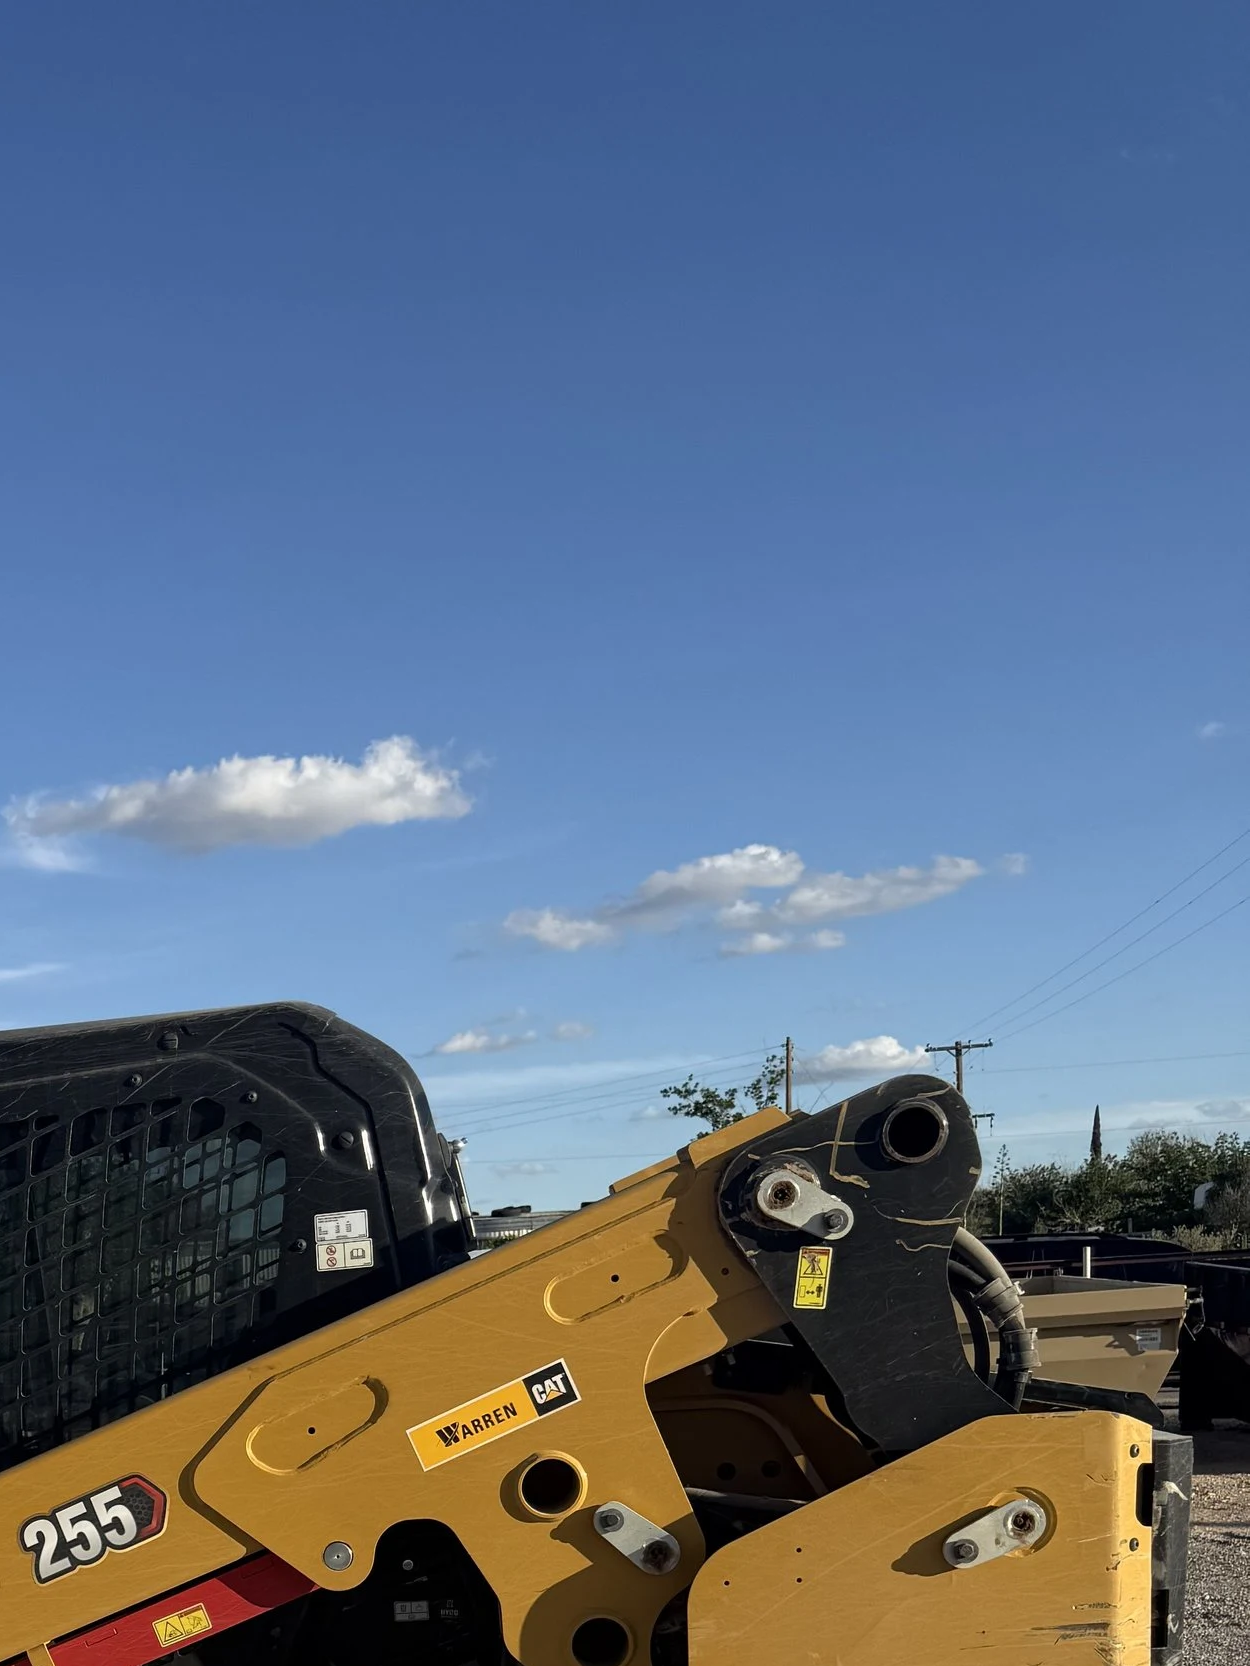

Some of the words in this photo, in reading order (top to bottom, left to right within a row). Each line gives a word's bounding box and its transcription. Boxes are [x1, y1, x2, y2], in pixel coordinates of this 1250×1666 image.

[435, 1402, 518, 1447] WARREN
[531, 1373, 567, 1405] CAT
[23, 1485, 137, 1580] 255
